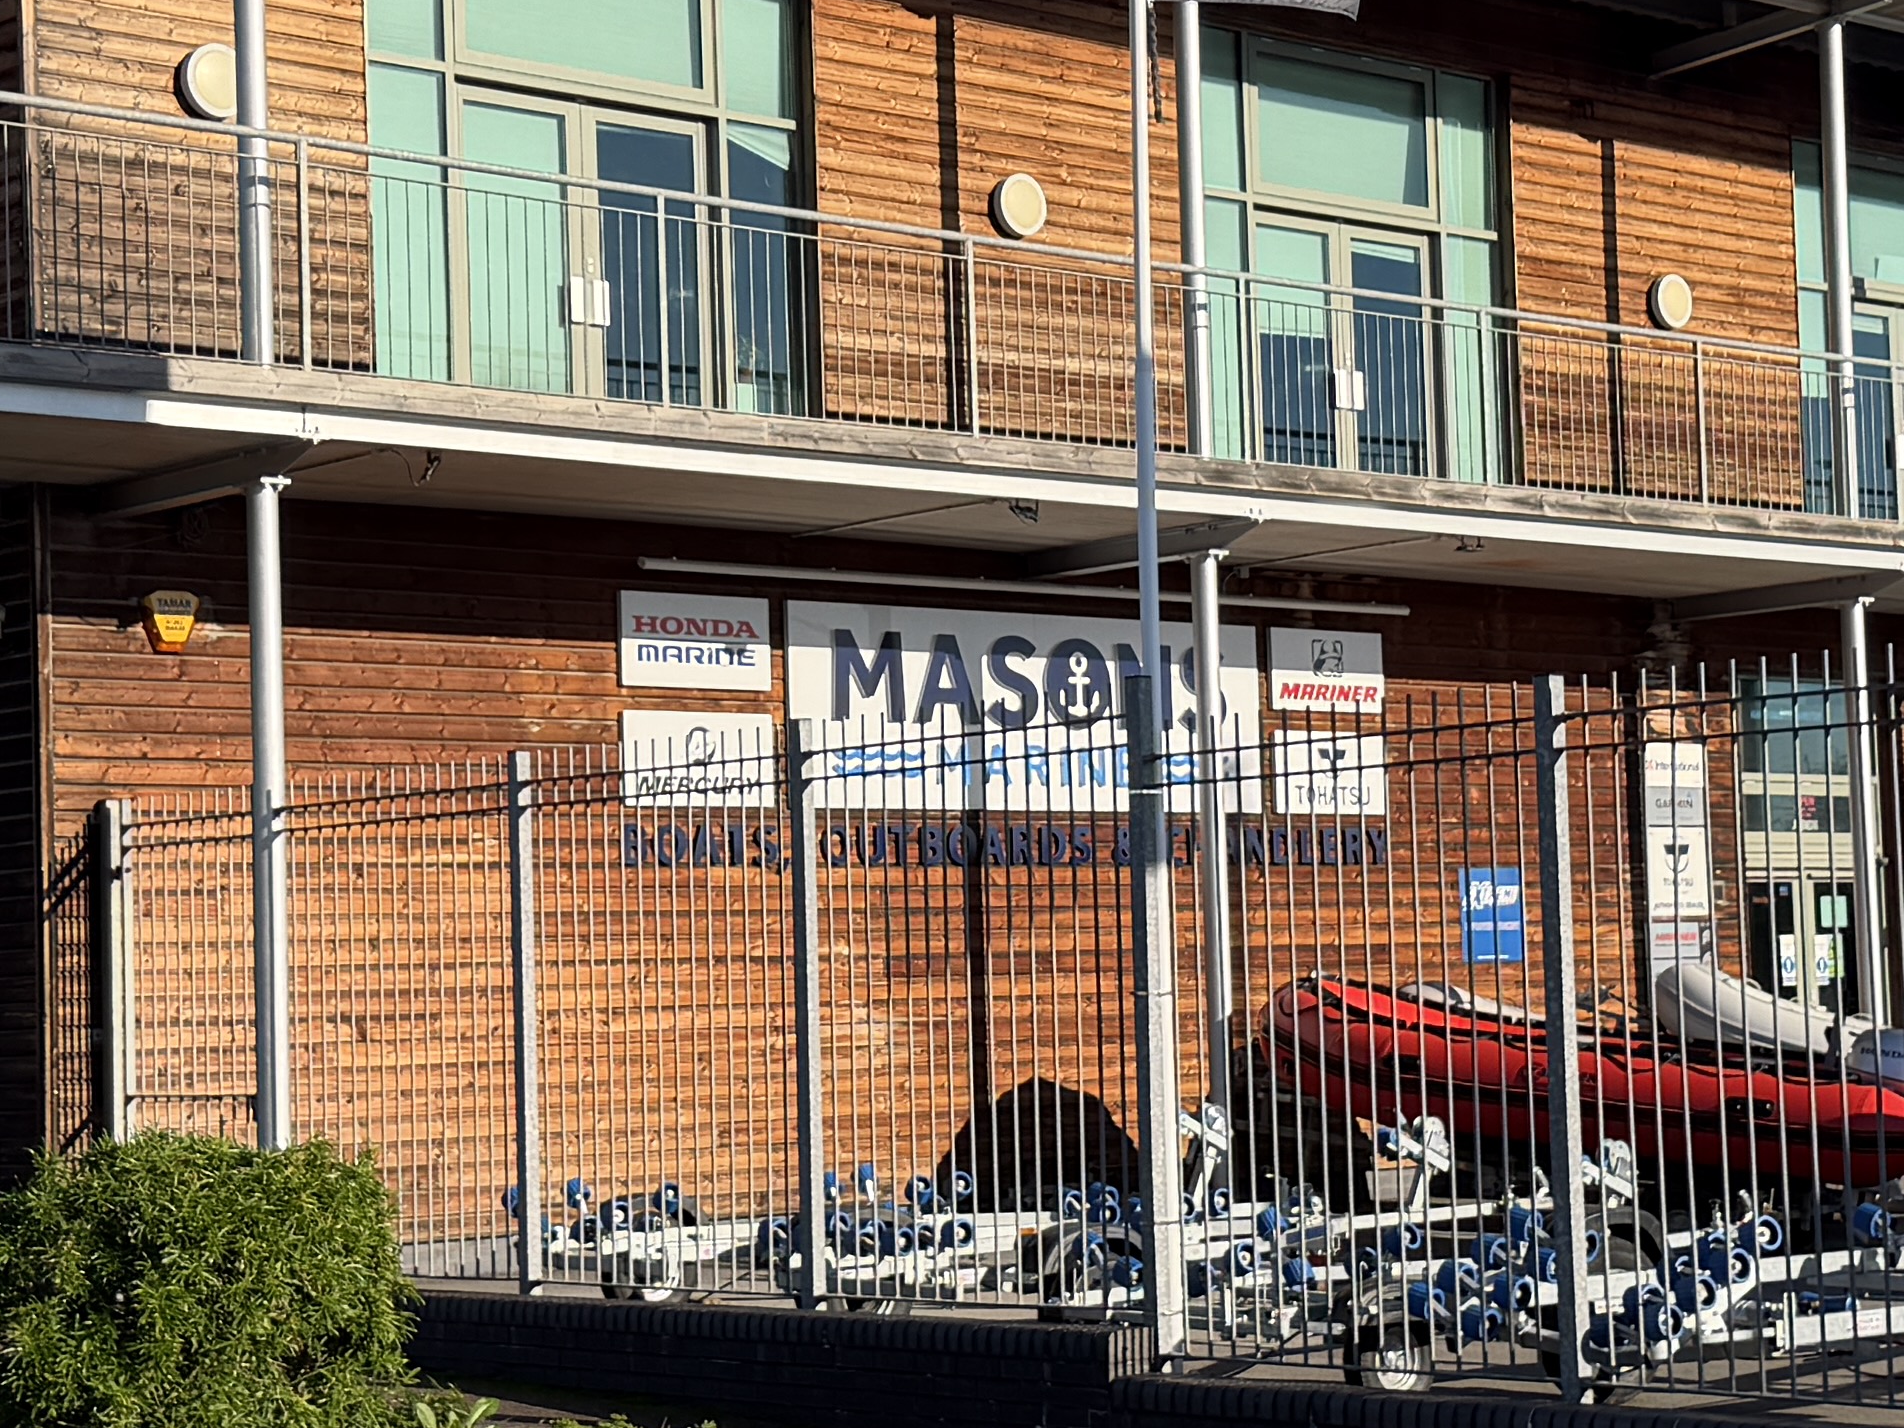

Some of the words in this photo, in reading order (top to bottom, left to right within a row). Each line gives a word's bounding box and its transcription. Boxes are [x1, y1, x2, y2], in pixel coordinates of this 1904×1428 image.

[632, 615, 759, 639] HONDA
[637, 644, 756, 667] MARINE
[831, 629, 1227, 733] MASONS
[1279, 682, 1379, 703] MARINER
[820, 822, 1093, 866] OUTBOARDS
